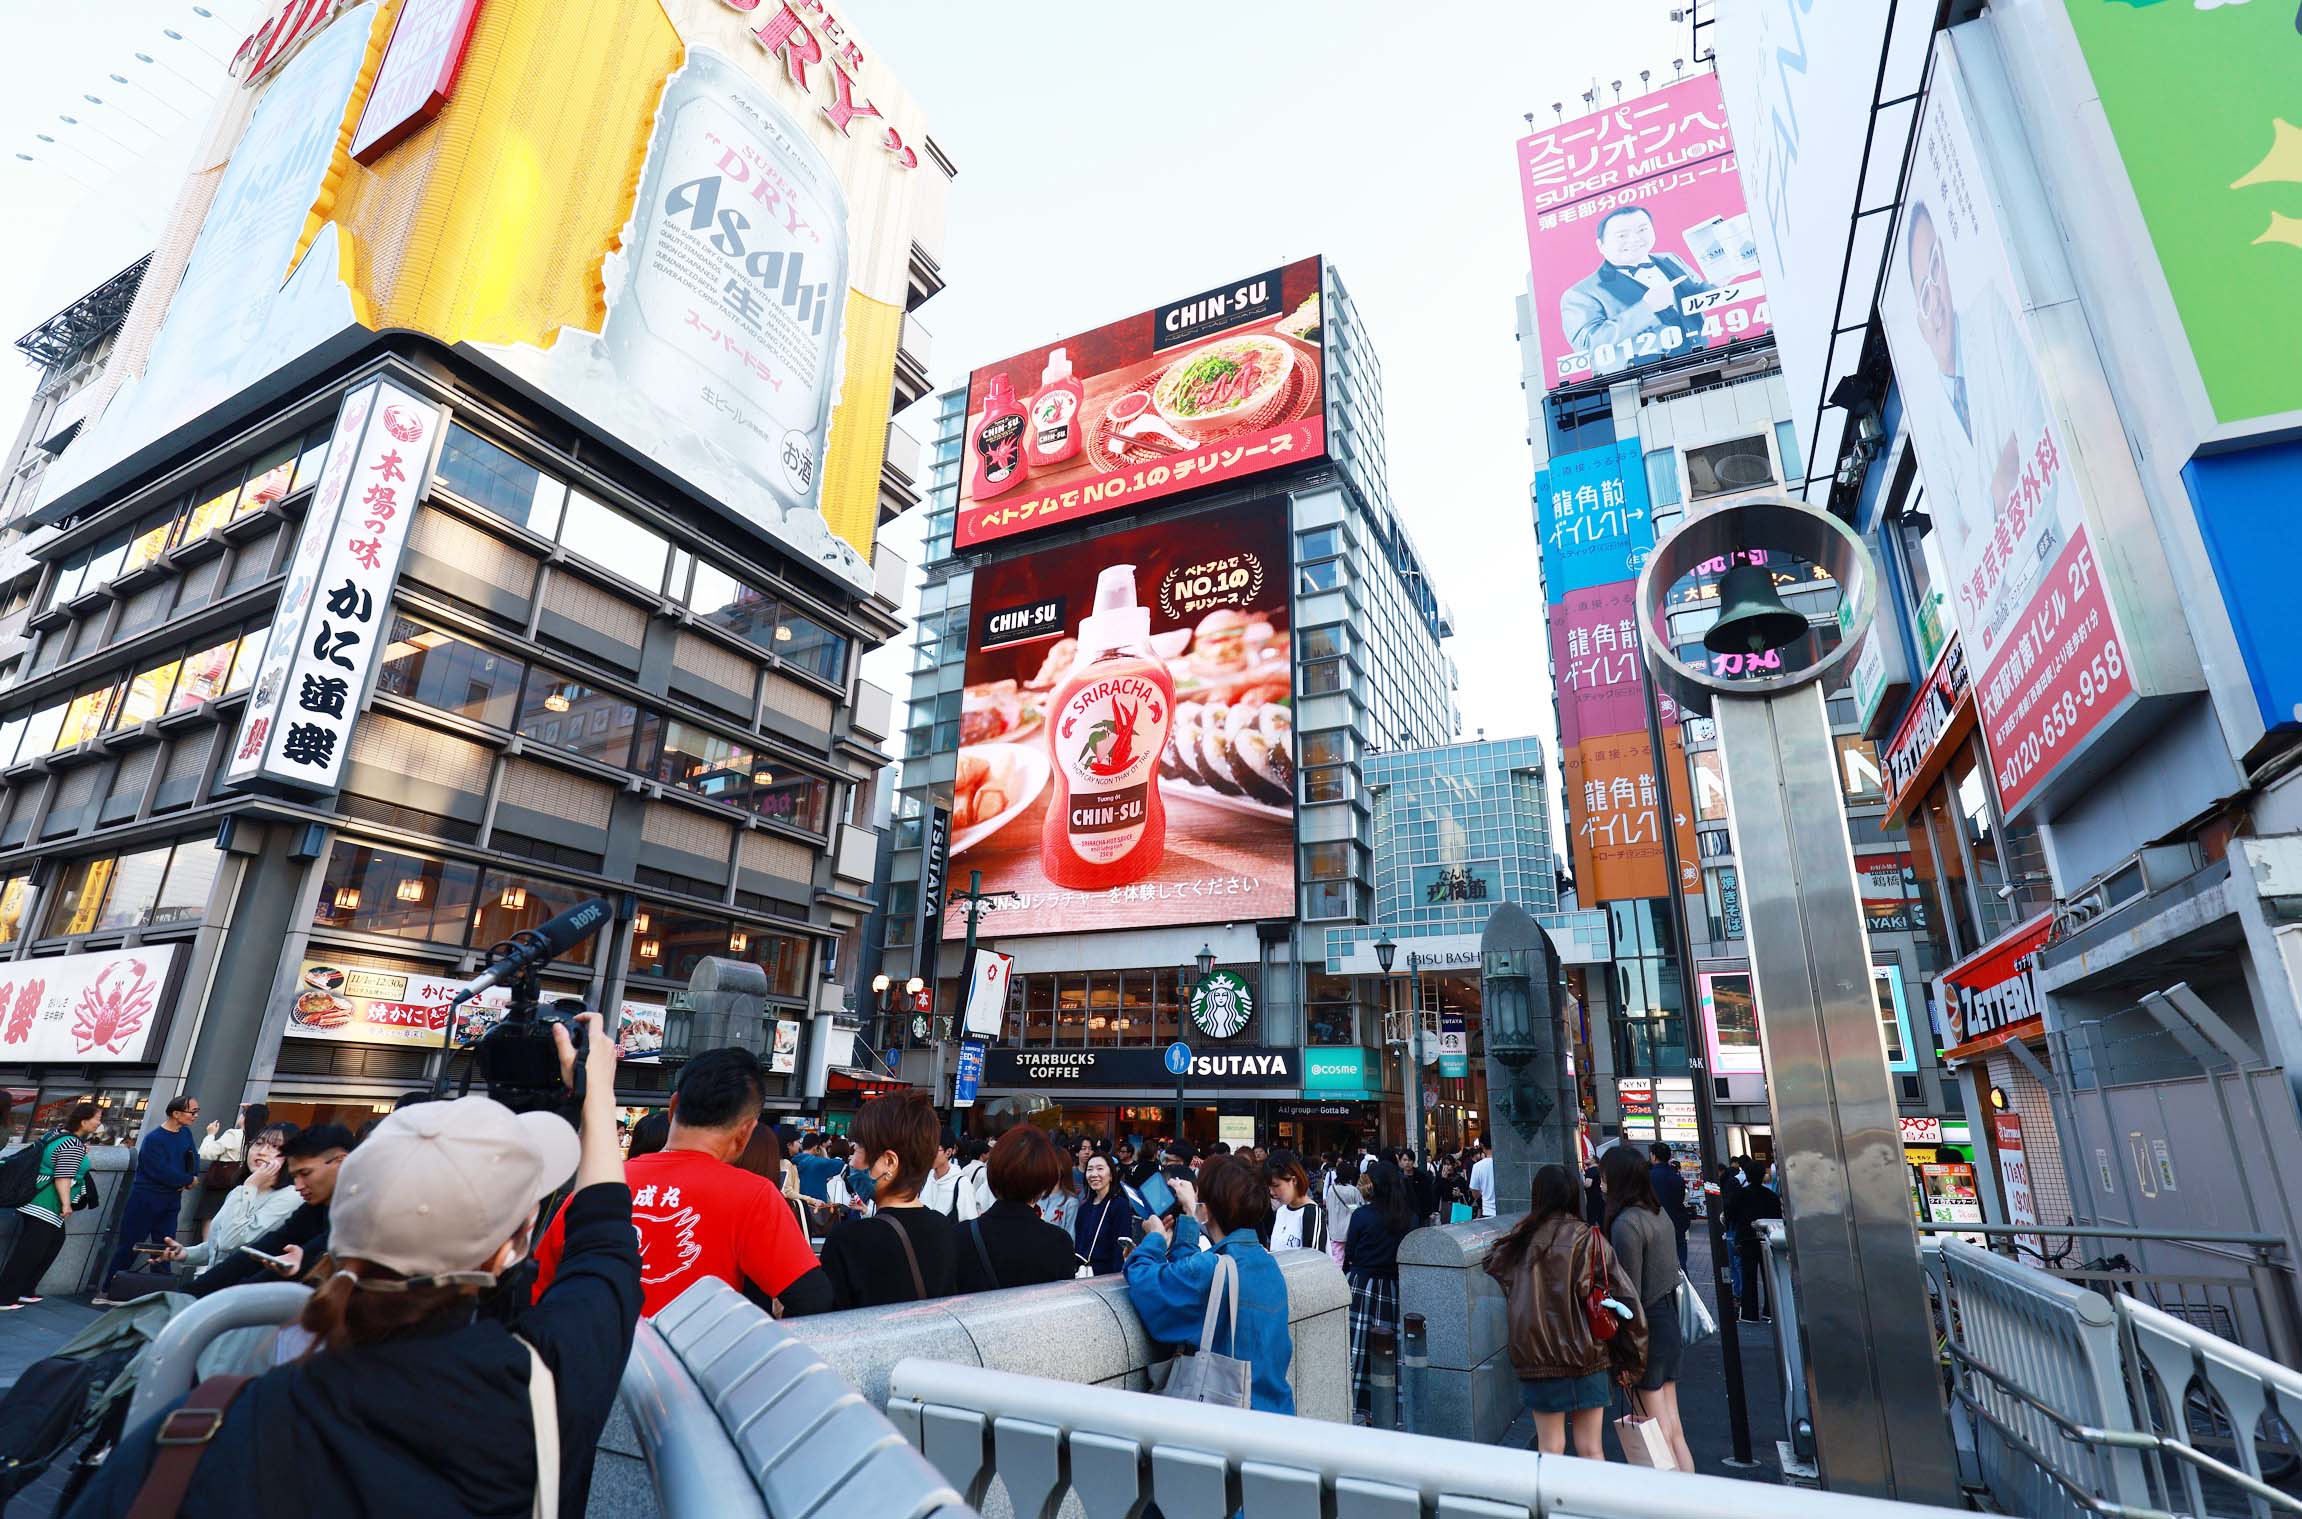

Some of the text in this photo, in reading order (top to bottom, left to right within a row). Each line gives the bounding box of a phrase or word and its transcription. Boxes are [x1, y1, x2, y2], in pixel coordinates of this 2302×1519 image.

[1535, 135, 1727, 210] SUPER MILLION
[664, 175, 828, 336] Asahi
[1689, 289, 1740, 311] ルアン
[683, 308, 784, 394] スーパードライ
[700, 385, 746, 425] 生ビール
[783, 441, 814, 487] お酒
[346, 449, 407, 571] 本場の味
[1552, 478, 1627, 520] 龍角散
[1972, 425, 2060, 609] 東京美容外科
[1185, 557, 1240, 577] ベトナムで
[1175, 568, 1250, 601] NO.1の
[990, 604, 1057, 634] CHIN-SU
[1185, 593, 1239, 613] チリソース
[1983, 547, 2093, 725] 大阪駅前第1ビル 2F
[1073, 679, 1153, 715] SRIRACHA
[2006, 639, 2122, 788] 0120-658-958
[1072, 801, 1143, 826] CHIN-SU
[925, 818, 945, 918] TSUTAYA
[1439, 868, 1473, 880] なんば
[367, 1003, 424, 1024] 焼かに
[1016, 1053, 1095, 1066] STARBUCKS
[1030, 1066, 1079, 1078] COFFEE
[1187, 1055, 1287, 1075] TSUTAYA
[1311, 1064, 1358, 1075] @cosme
[1320, 1106, 1339, 1114] Gotta
